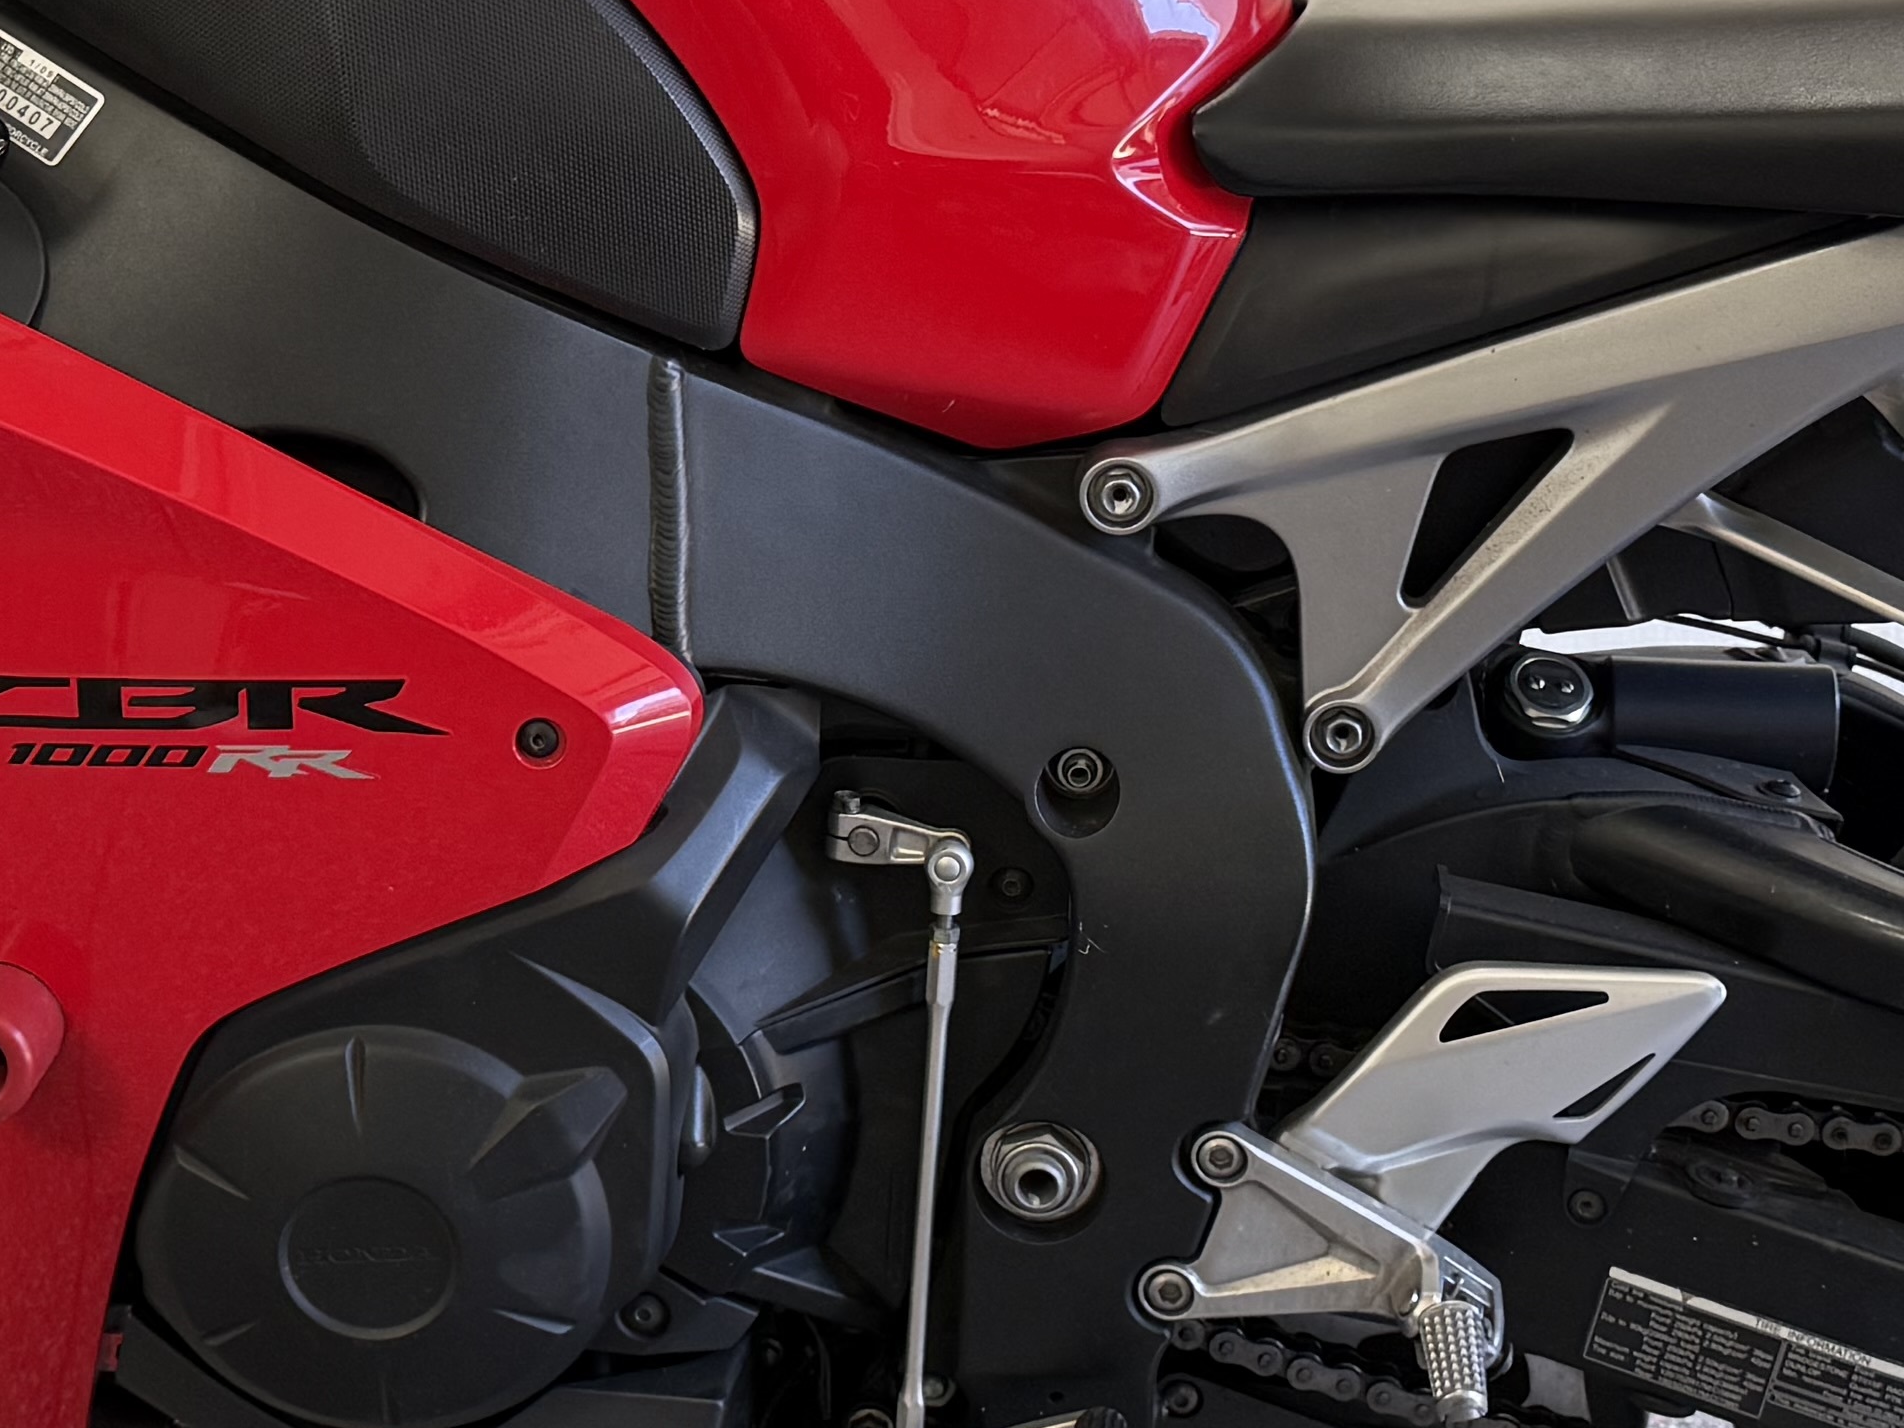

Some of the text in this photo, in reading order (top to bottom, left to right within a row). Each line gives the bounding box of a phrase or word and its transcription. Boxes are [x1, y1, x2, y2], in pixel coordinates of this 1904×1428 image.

[6, 124, 49, 157] ORCYCLE
[296, 1245, 441, 1267] HONDA
[1788, 1329, 1871, 1366] INFORMATION
